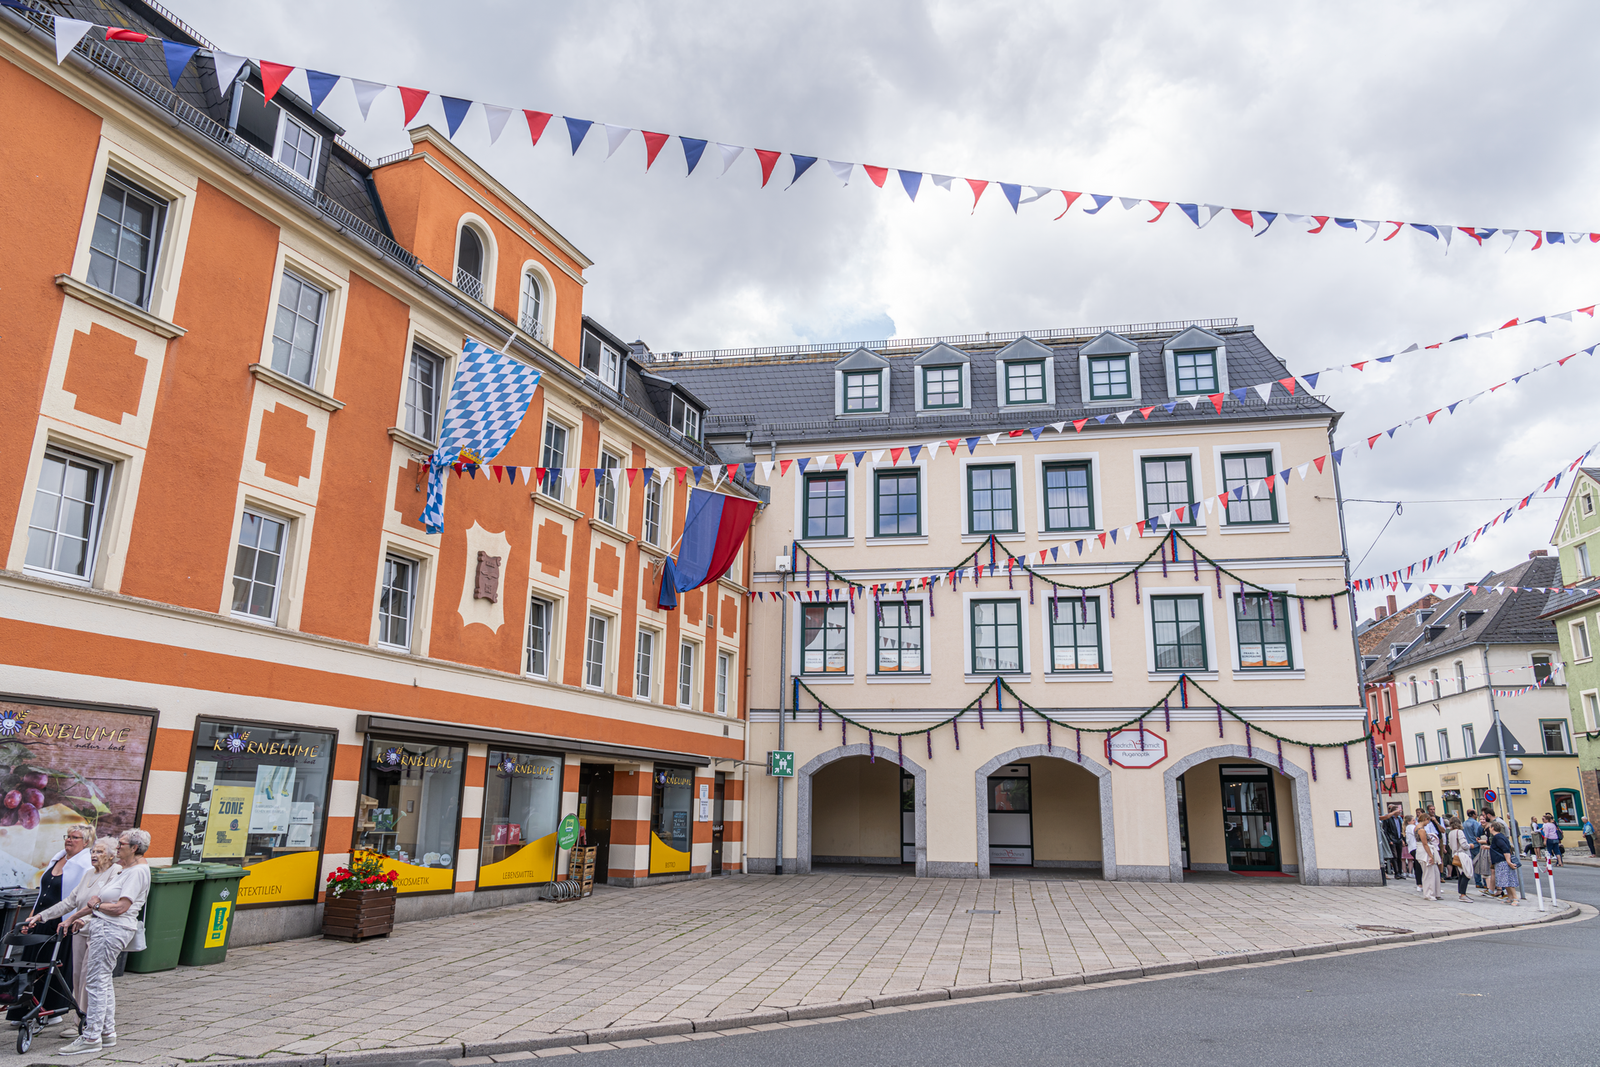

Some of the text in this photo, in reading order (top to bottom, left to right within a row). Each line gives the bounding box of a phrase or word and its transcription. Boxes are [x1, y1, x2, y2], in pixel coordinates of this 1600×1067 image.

[218, 801, 244, 815] ZONE
[502, 870, 534, 880] LEBENSMITTEL
[238, 885, 283, 897] RTEXTILIEN
